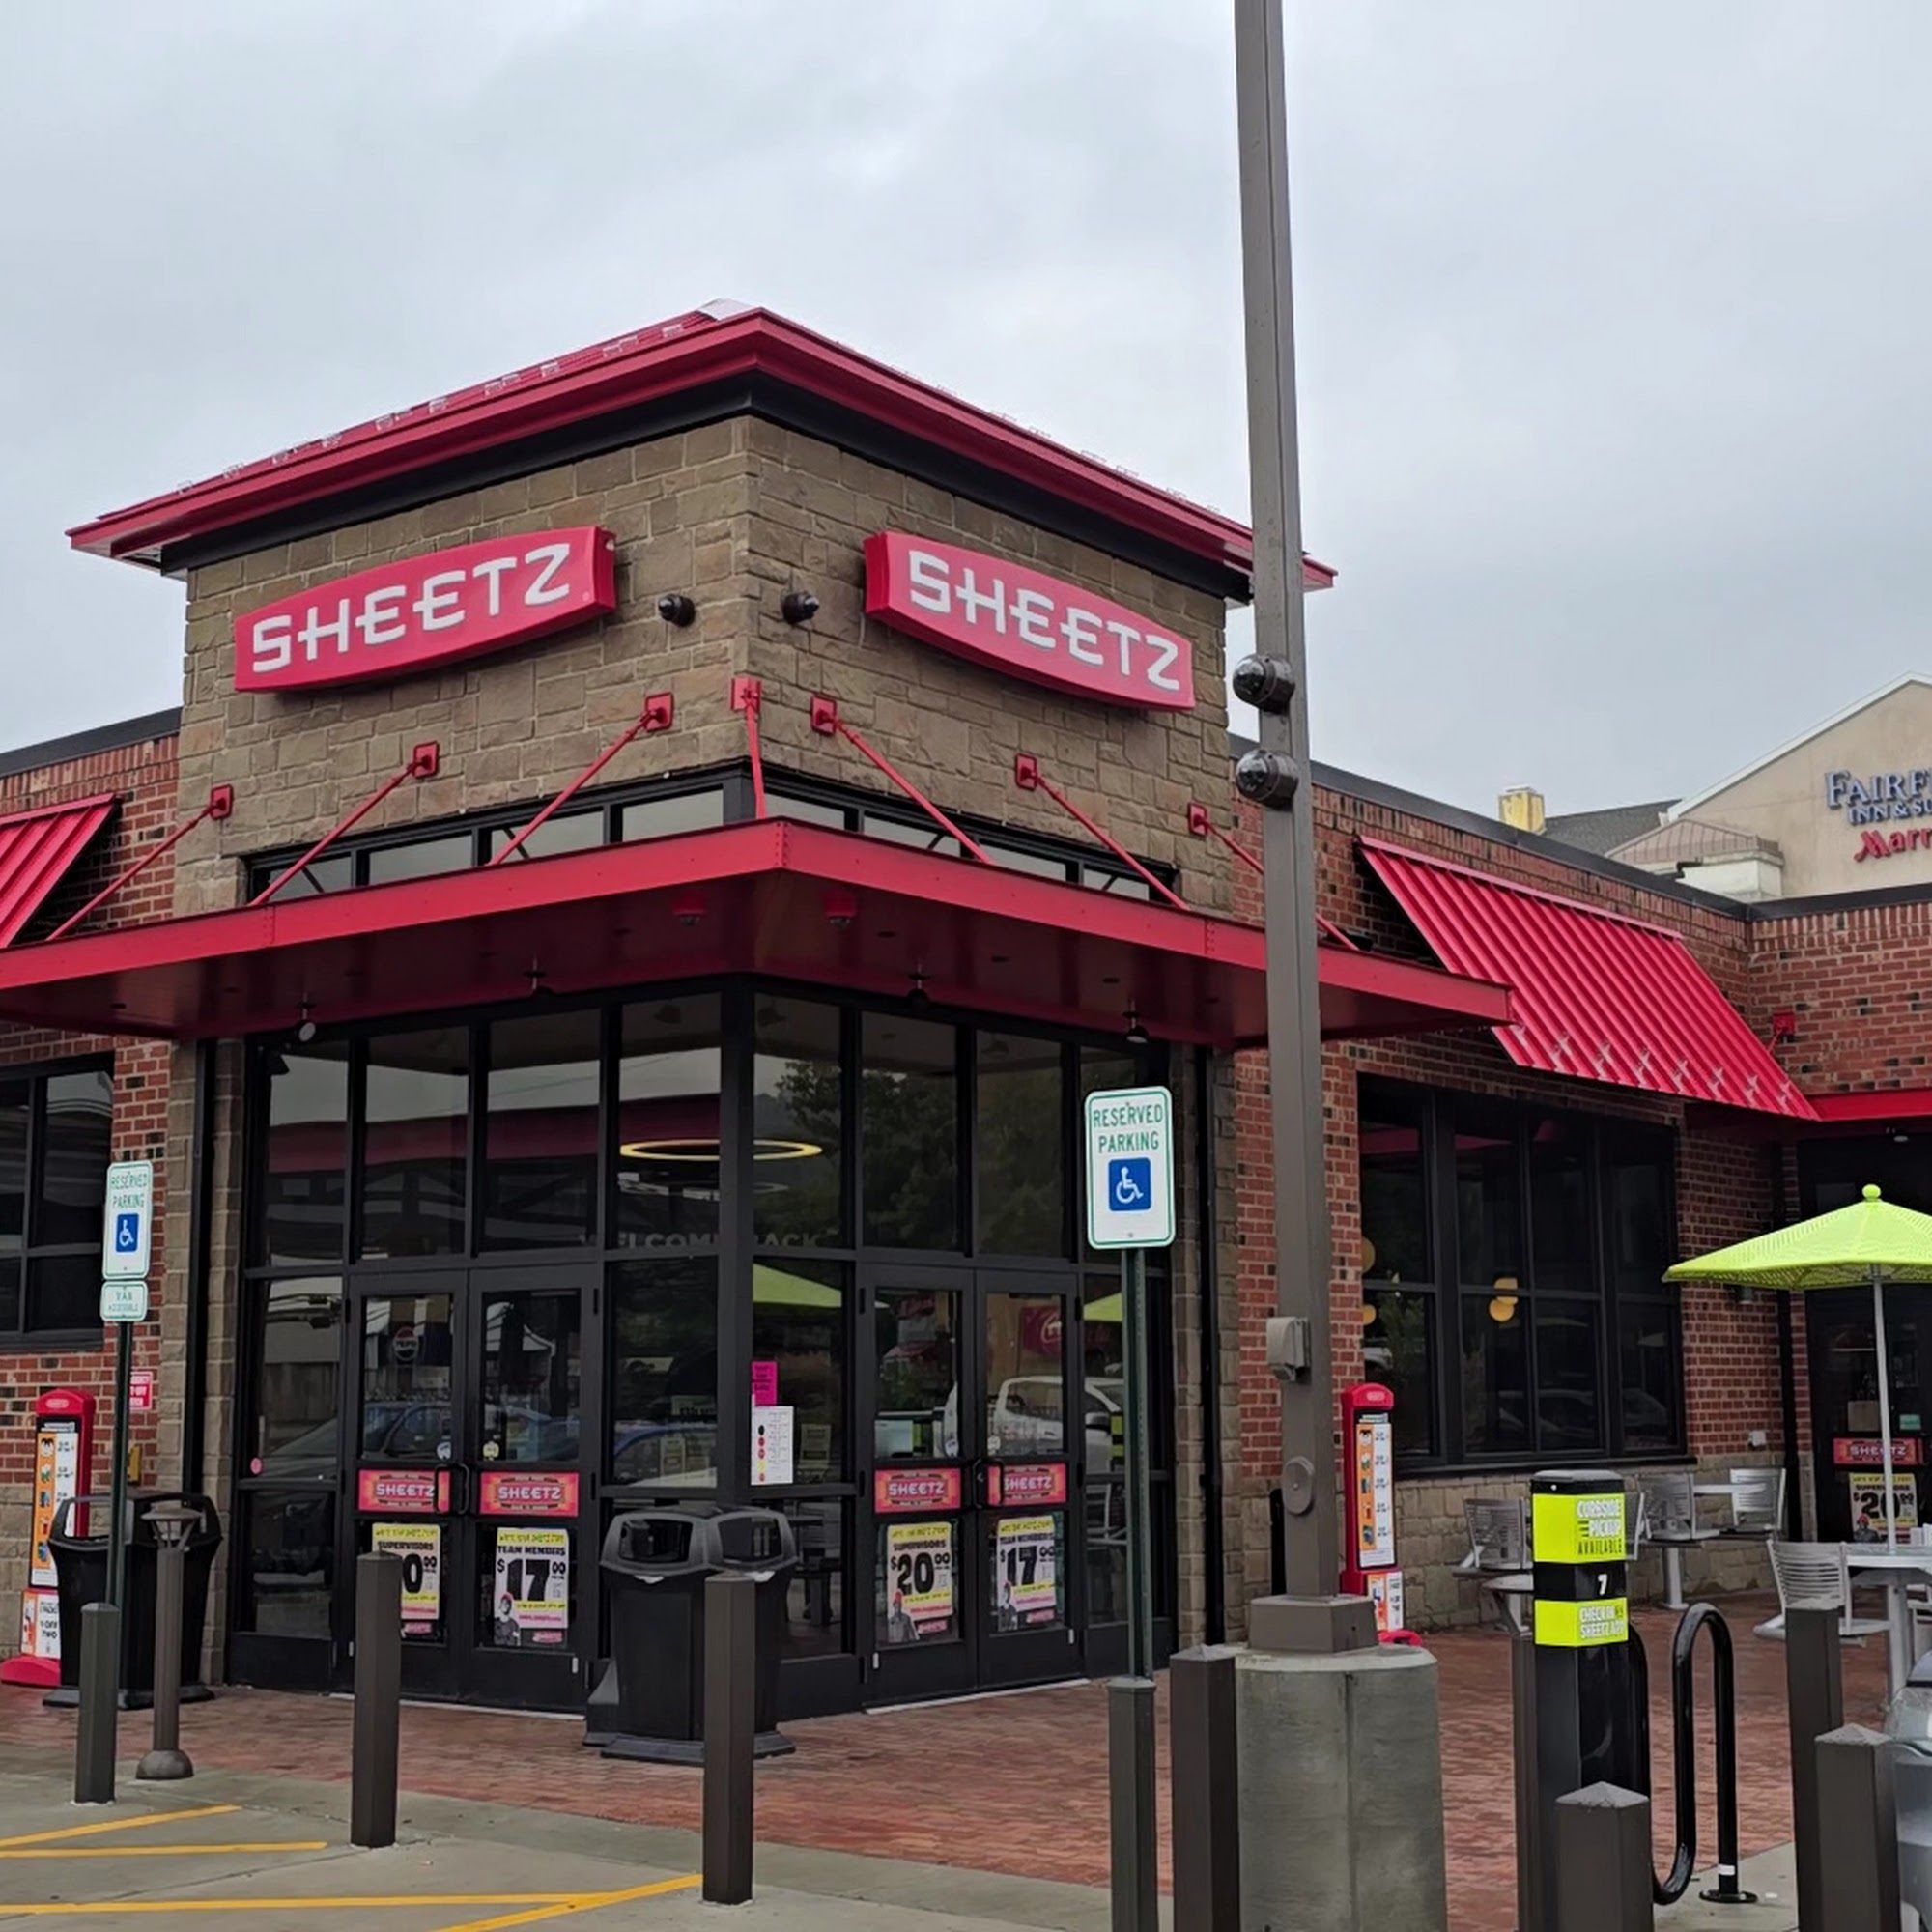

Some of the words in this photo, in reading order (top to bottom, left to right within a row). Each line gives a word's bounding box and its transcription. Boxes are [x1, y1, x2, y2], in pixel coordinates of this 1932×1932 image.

[253, 542, 571, 673] SHEETZ
[908, 549, 1180, 691] SHEETZ
[1848, 803, 1890, 826] INN
[1892, 801, 1911, 819] &
[1094, 1103, 1163, 1128] RESERVED
[1097, 1131, 1159, 1154] PARKING
[111, 1173, 147, 1189] RESERVED
[112, 1193, 144, 1208] PARKING
[1849, 1444, 1907, 1457] SHETZ
[376, 1483, 435, 1497] SHEETZ
[888, 1481, 945, 1496] SHEETZ
[1003, 1476, 1052, 1491] SHEETZ
[498, 1486, 562, 1500] SHEETZ
[497, 1546, 522, 1554] TEAM
[525, 1547, 566, 1556] MEMBERS
[1578, 1538, 1622, 1555] AVAILABLE
